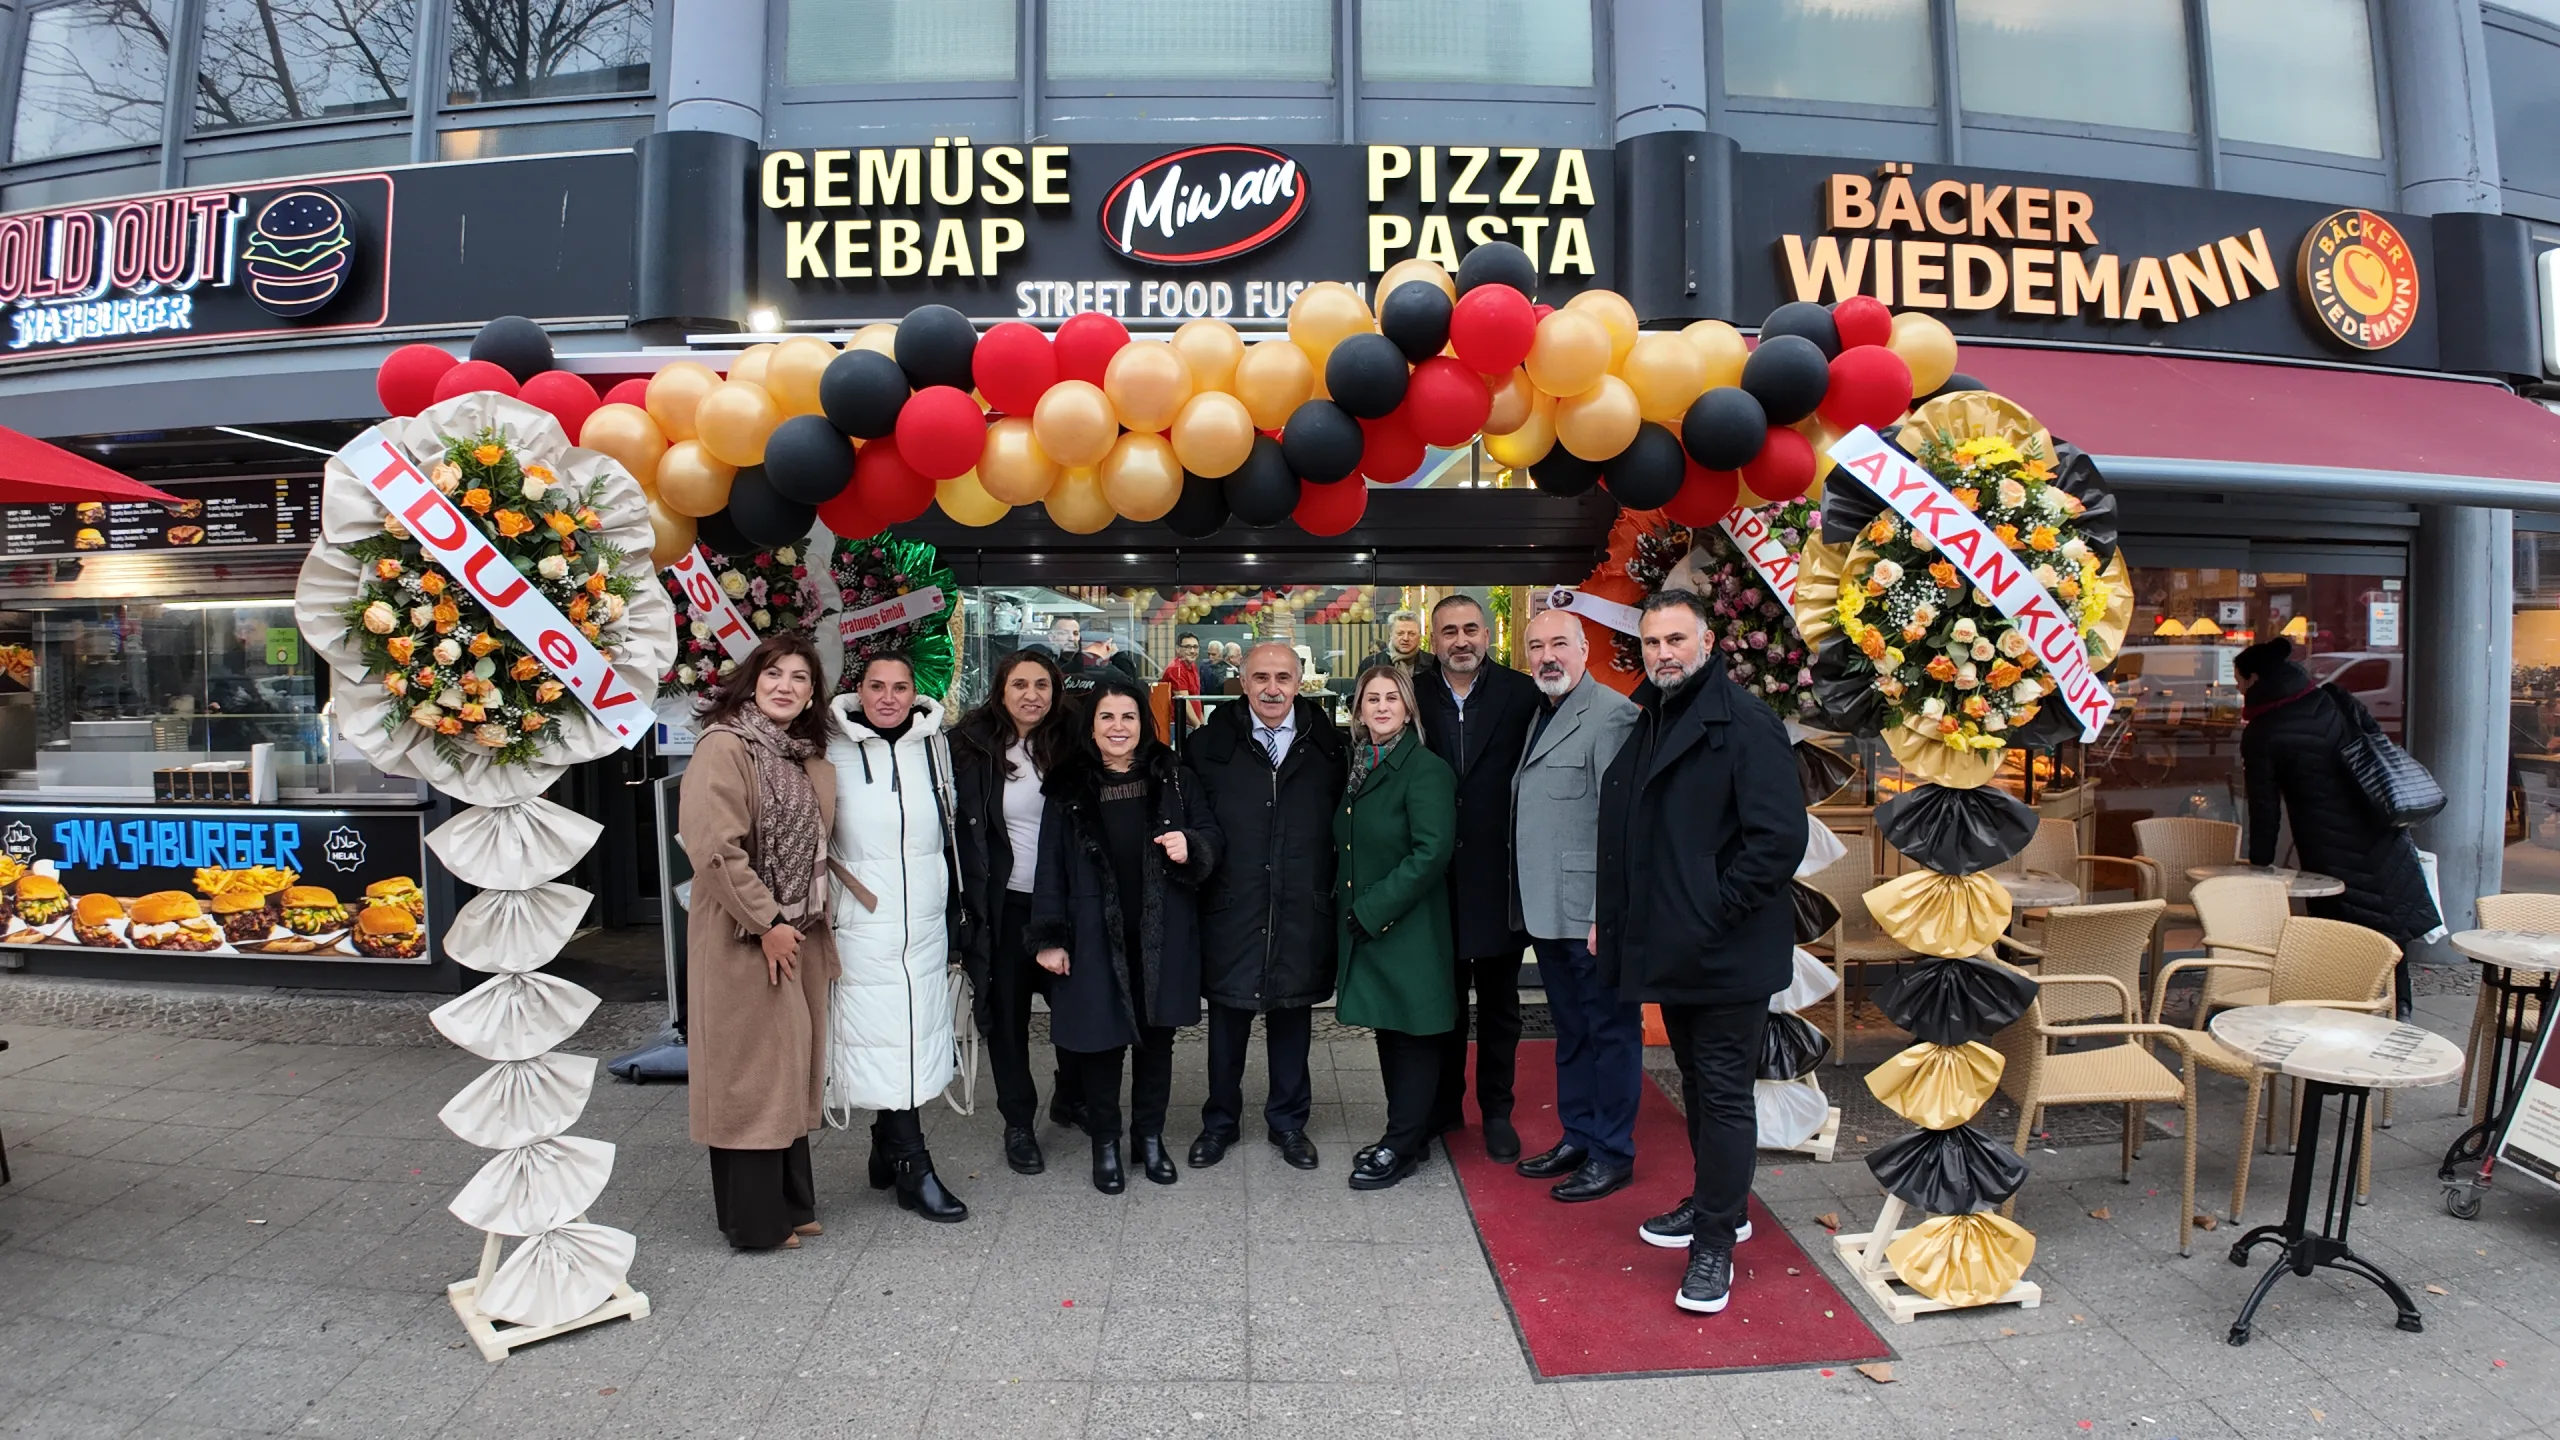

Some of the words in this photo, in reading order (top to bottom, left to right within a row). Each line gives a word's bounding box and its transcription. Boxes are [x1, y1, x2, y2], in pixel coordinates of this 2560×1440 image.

[762, 137, 1070, 208] GEMÜSE
[1368, 145, 1595, 205] PIZZA
[1122, 160, 1295, 252] Miwan
[1828, 162, 2099, 245] BÄCKER
[111, 193, 231, 288] OUT
[786, 218, 1025, 278] KEBAP
[1368, 214, 1595, 275] PASTA
[2318, 219, 2403, 265] BÄCKER
[1016, 281, 1130, 317] STREET
[1141, 281, 1232, 317] FOOD
[1246, 281, 1366, 317] FUS
[1781, 228, 2279, 323] WIEDEMANN
[2315, 268, 2411, 341] WIEDEMANN
[371, 441, 530, 608] TDU
[539, 629, 637, 736] e.V.
[880, 602, 907, 624] GmbH
[1848, 452, 2020, 598] AYKAN
[2013, 595, 2108, 730] KÜTÜK
[54, 819, 303, 873] SMASHBURGER
[331, 835, 358, 850] حلال
[331, 852, 360, 860] HELAL
